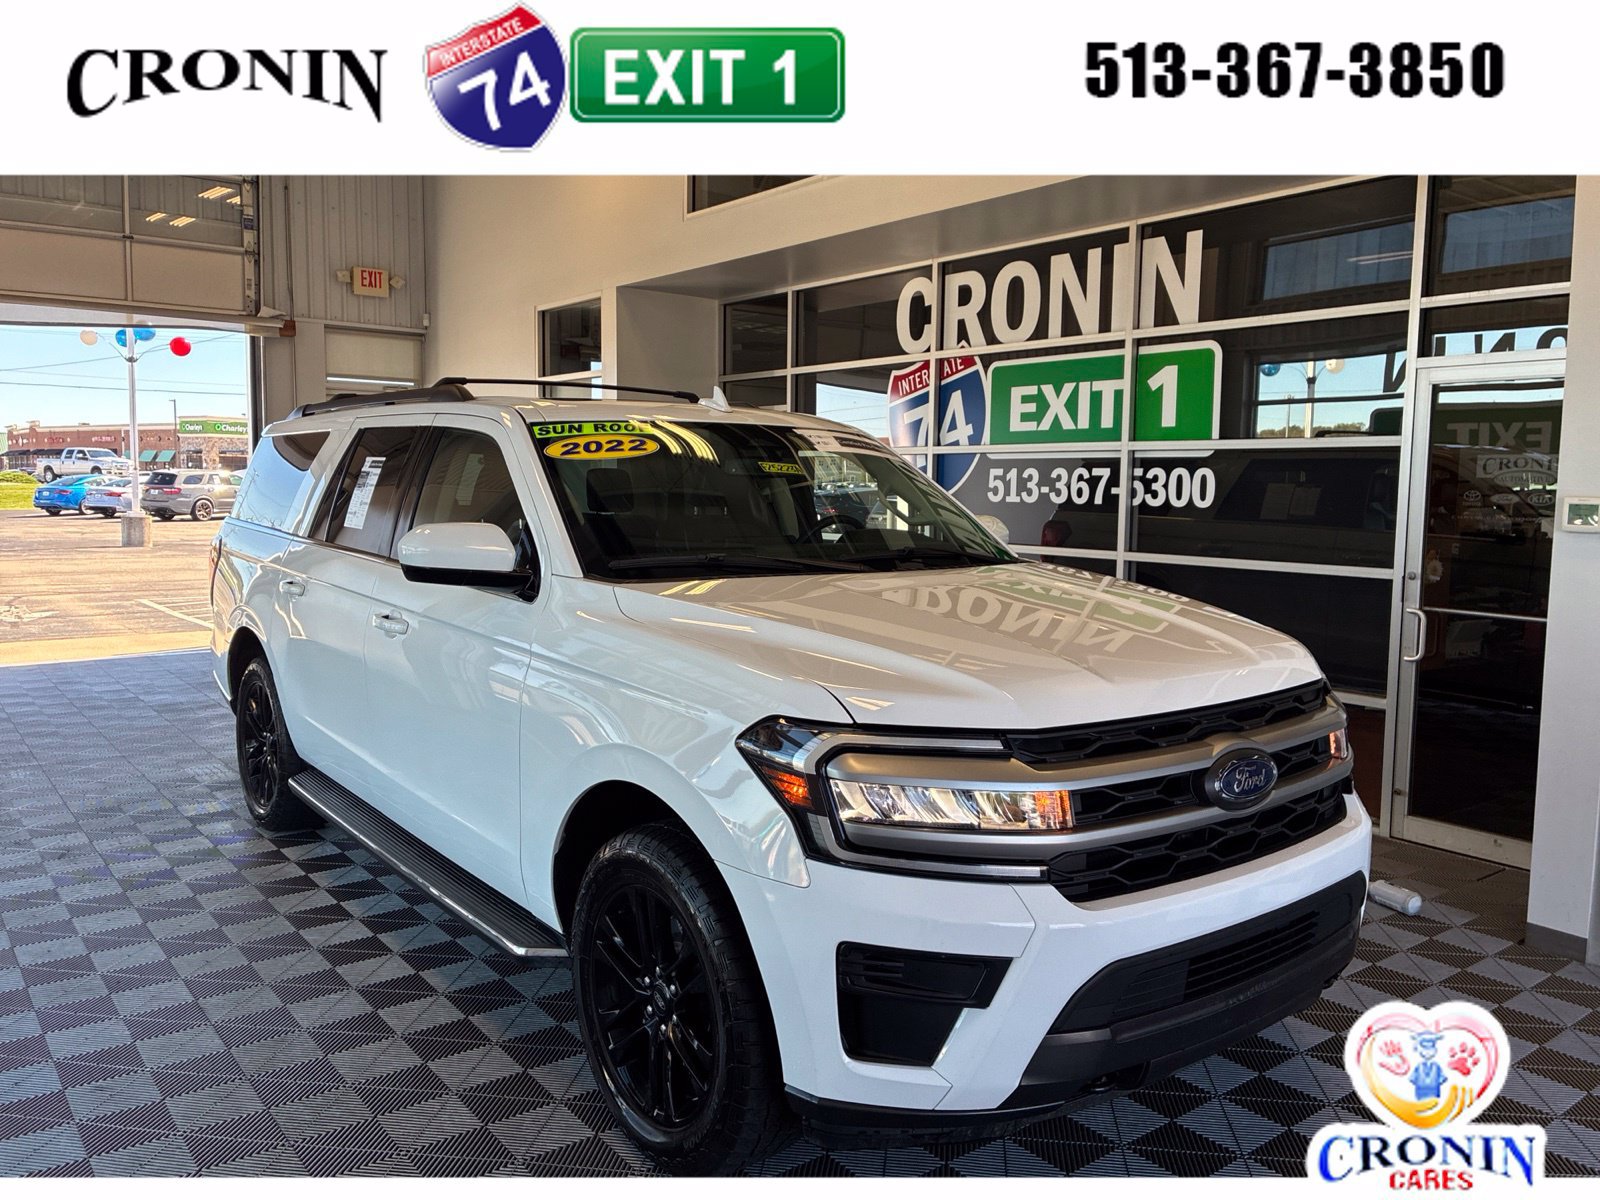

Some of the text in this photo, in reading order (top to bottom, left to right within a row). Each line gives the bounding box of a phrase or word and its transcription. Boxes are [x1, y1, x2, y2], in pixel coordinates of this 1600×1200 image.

[361, 269, 383, 289] EXIT
[896, 229, 1204, 354] CRONIN
[898, 357, 965, 396] INTERATE
[1009, 364, 1179, 433] EXIT 1
[537, 422, 650, 436] SUN ROO
[903, 389, 974, 468] 74
[560, 438, 649, 456] 2022
[1481, 457, 1559, 475] CRONI
[987, 466, 1217, 509] 513-367-5300
[1233, 764, 1266, 793] Ford
